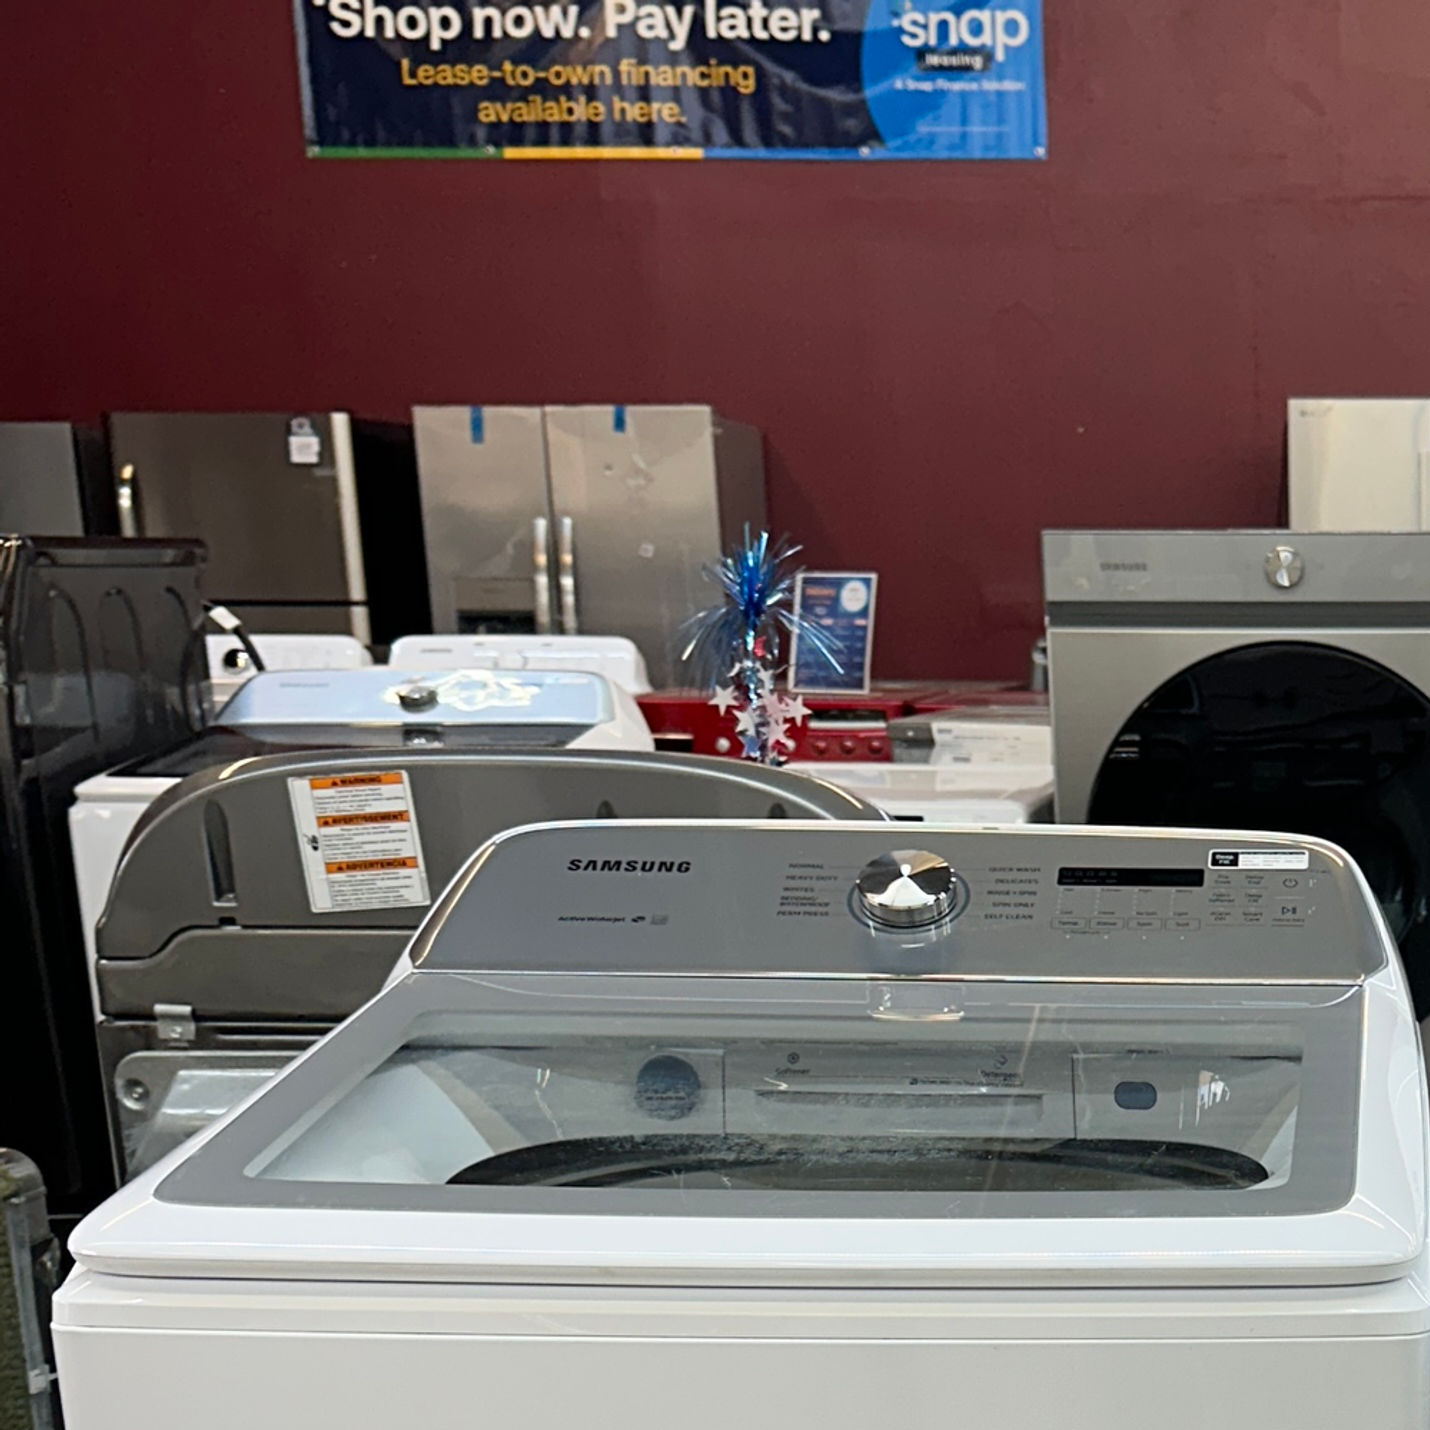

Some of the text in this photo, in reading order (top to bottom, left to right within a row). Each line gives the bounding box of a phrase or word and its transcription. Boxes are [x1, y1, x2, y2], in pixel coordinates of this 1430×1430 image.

[329, 0, 832, 51] Shop now. Pay later.
[900, 9, 1030, 63] snap
[400, 58, 756, 94] Lease-to-own financing
[477, 96, 688, 123] available here.
[567, 858, 691, 873] SAMSUNG
